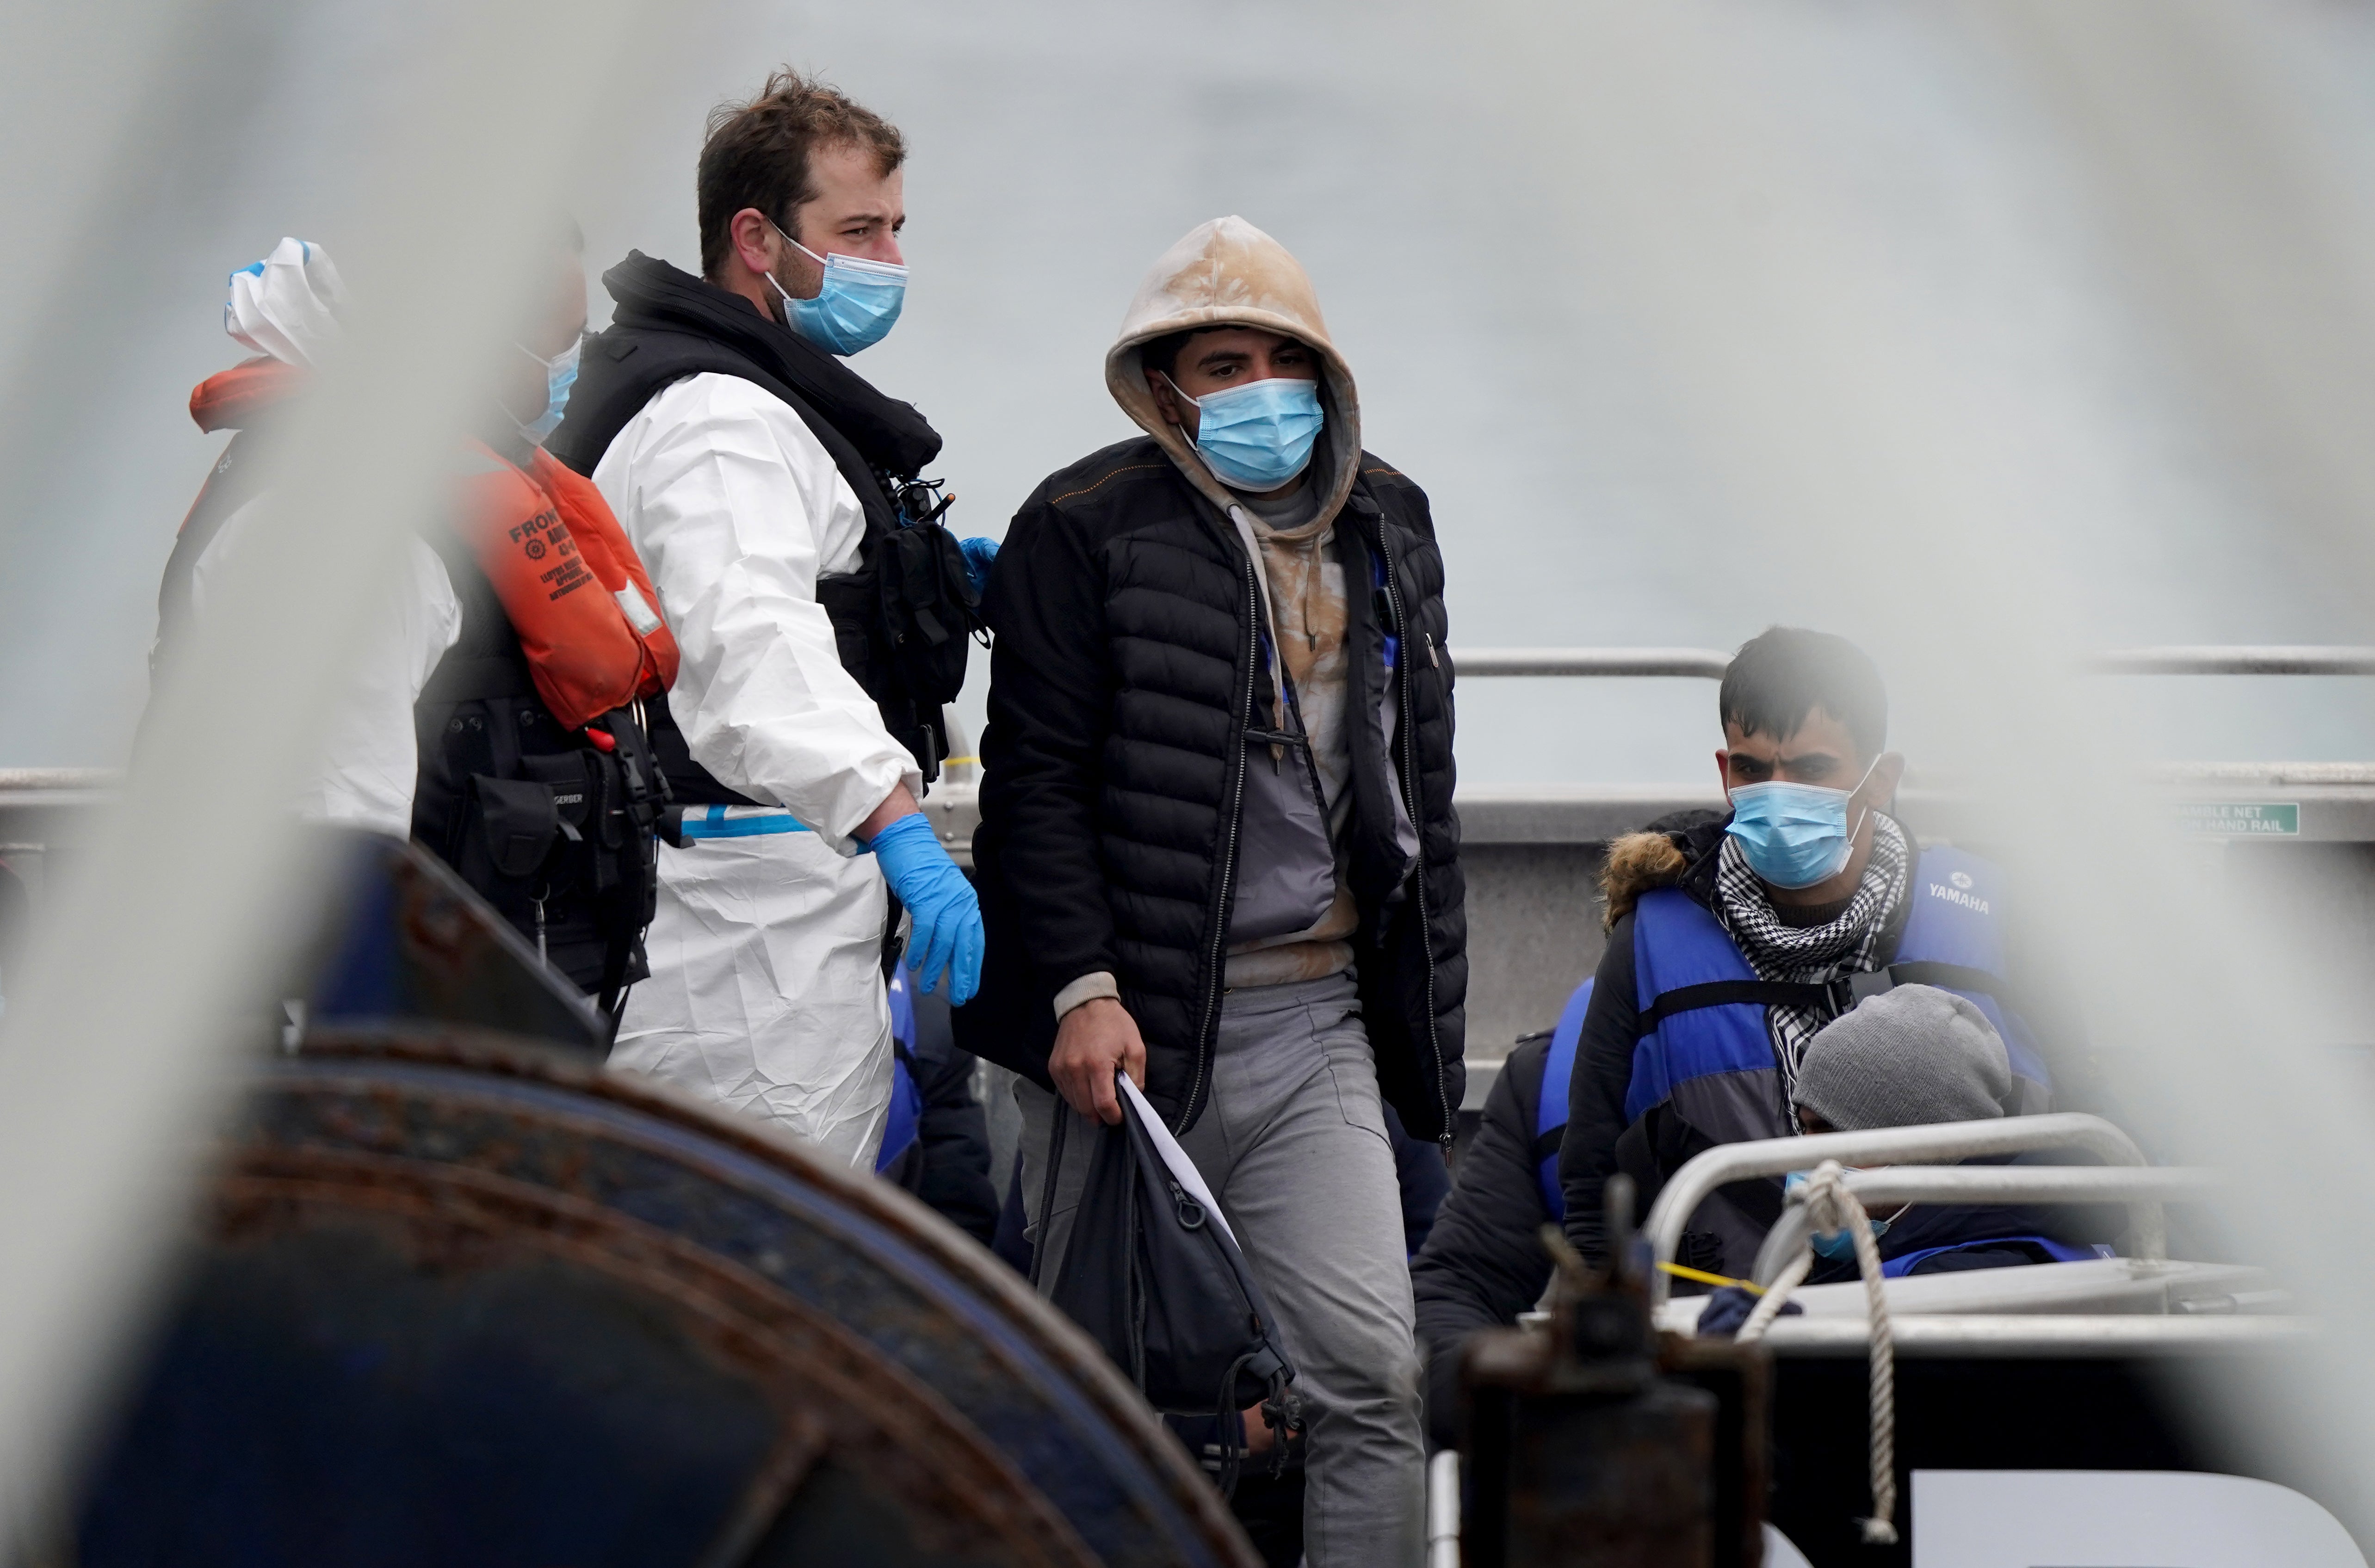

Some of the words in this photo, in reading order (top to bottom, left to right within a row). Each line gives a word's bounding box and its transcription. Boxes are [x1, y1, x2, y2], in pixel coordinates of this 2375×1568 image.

[2172, 806, 2229, 818] AMBLE
[2234, 806, 2262, 818] NET
[2206, 820, 2247, 831] HAND
[2251, 820, 2284, 832] RAIL
[1930, 883, 1989, 915] YAMAHA
